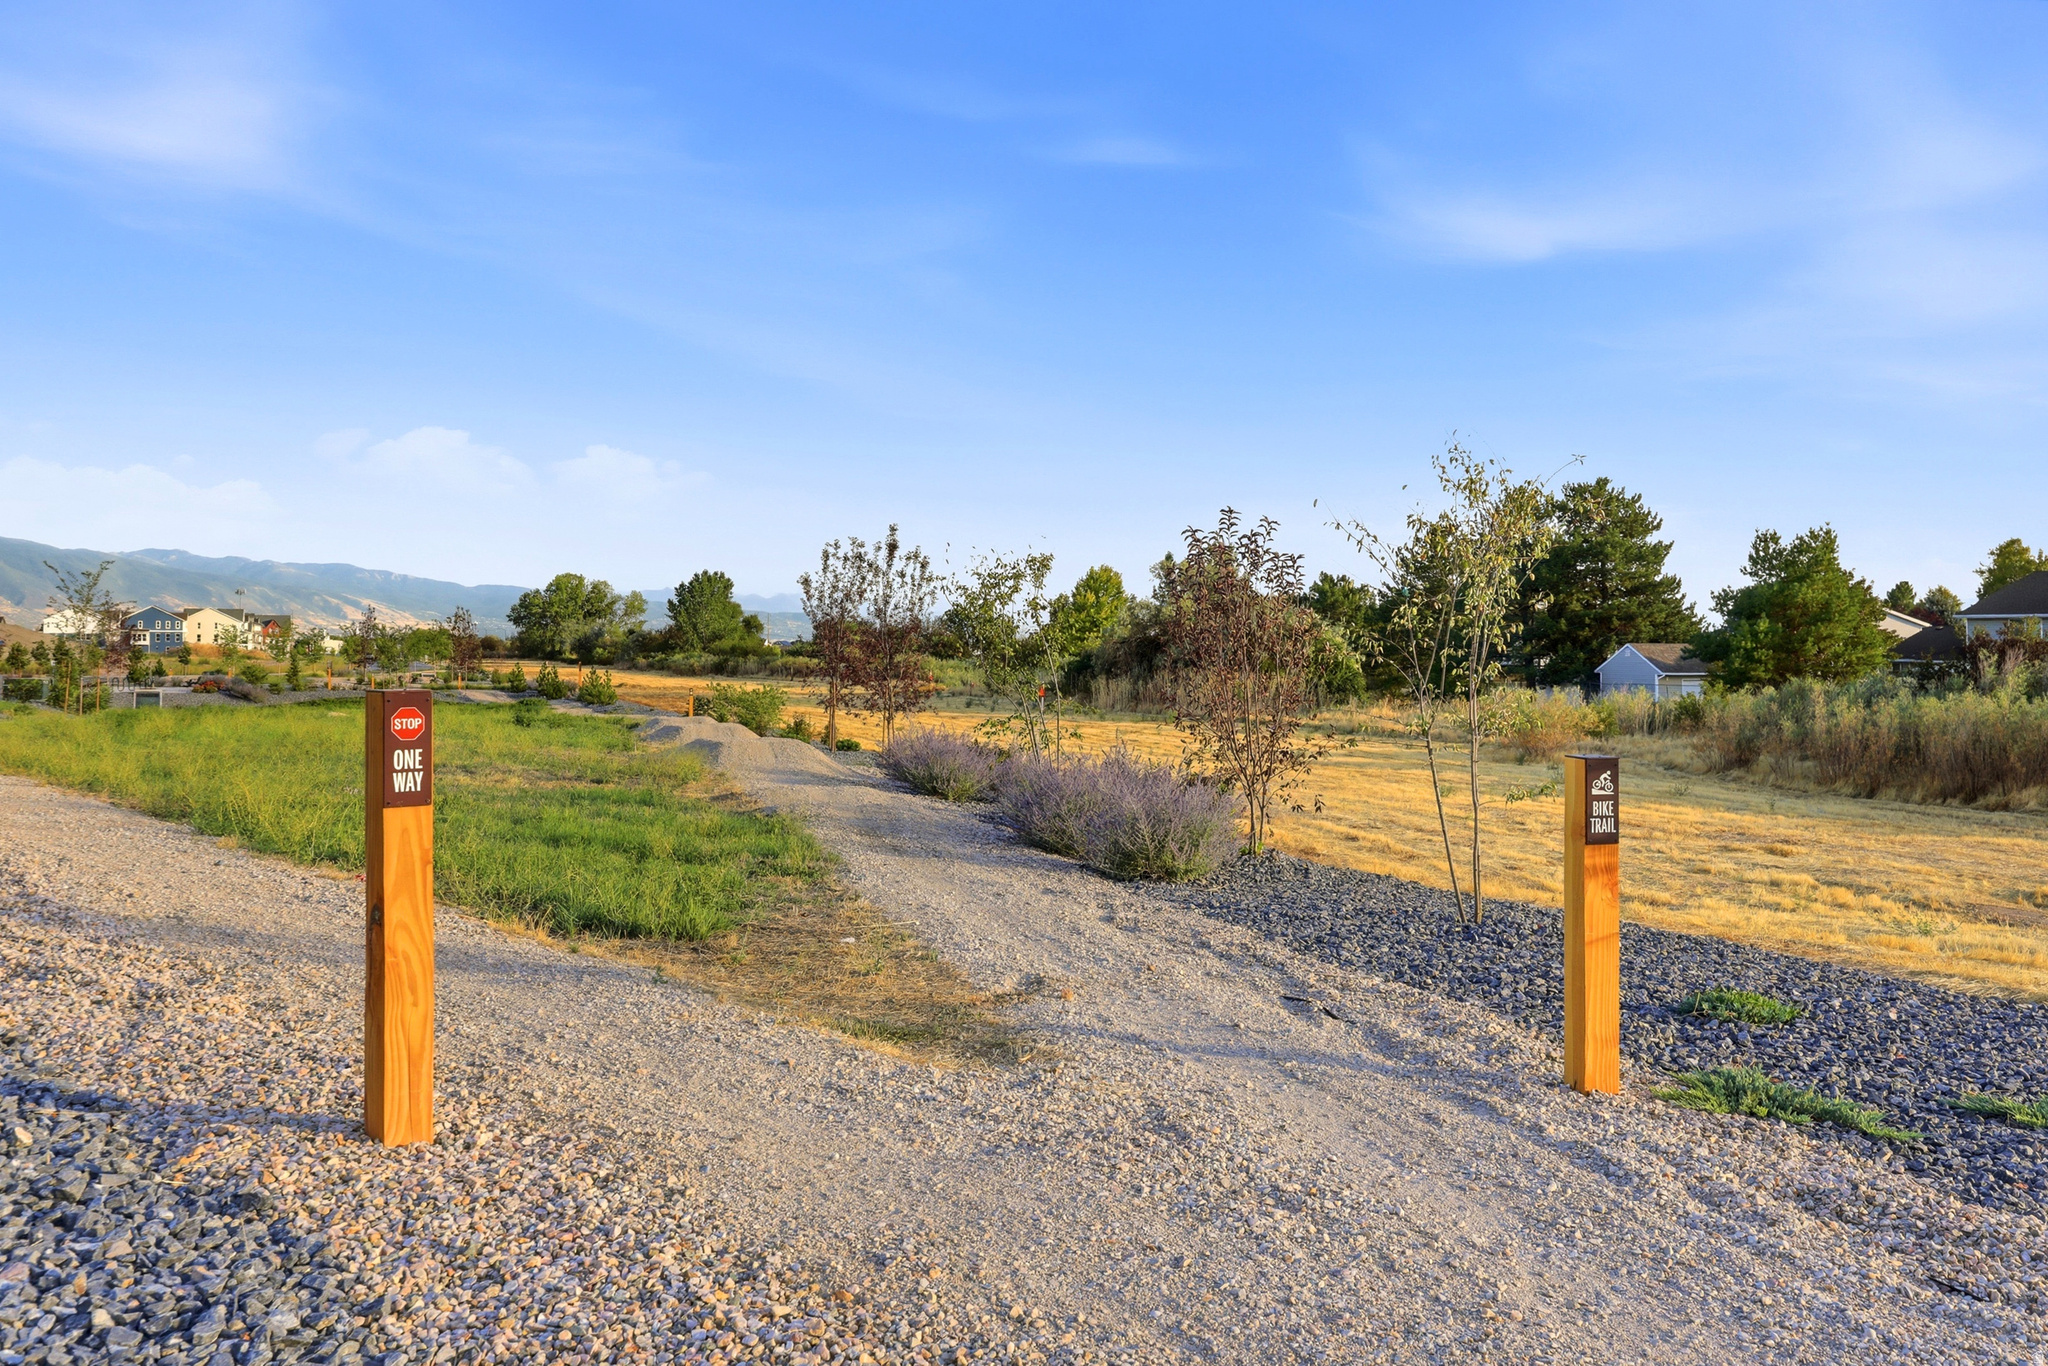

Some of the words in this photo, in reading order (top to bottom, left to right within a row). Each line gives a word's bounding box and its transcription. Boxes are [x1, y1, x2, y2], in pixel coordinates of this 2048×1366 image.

[394, 718, 422, 730] STOP
[393, 749, 423, 770] ONE
[392, 771, 424, 793] WAY
[1592, 801, 1614, 816] BIKE
[1590, 818, 1616, 833] TRAIL
